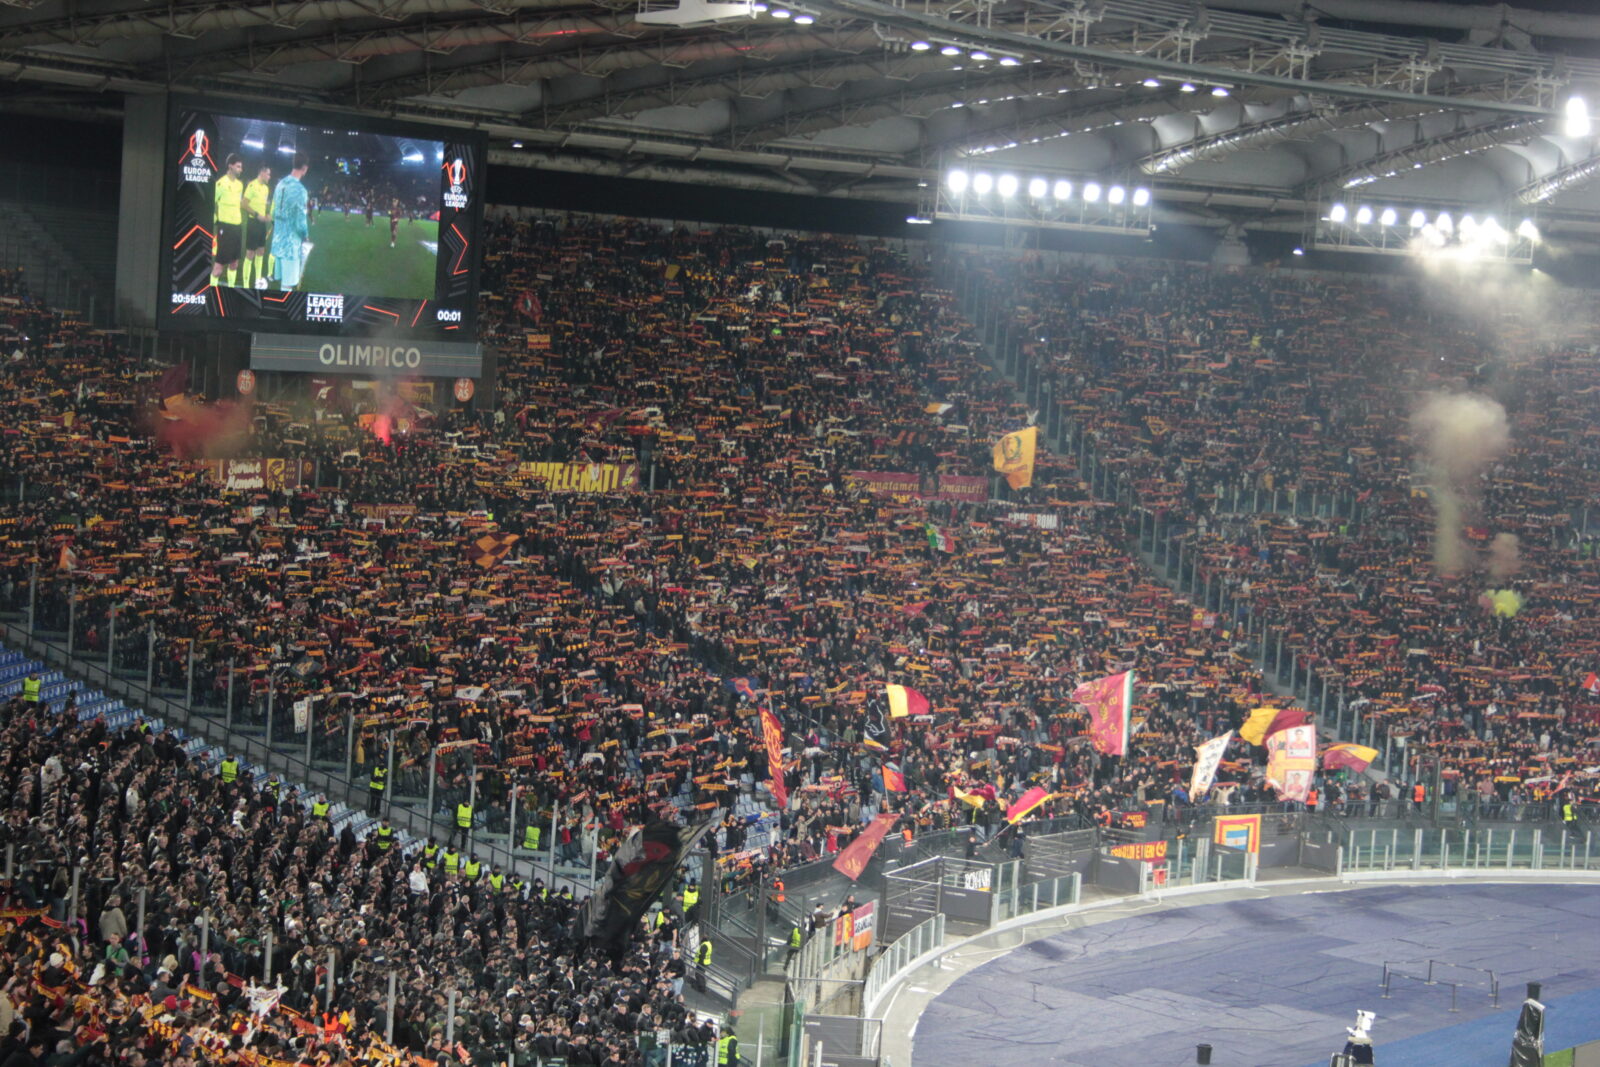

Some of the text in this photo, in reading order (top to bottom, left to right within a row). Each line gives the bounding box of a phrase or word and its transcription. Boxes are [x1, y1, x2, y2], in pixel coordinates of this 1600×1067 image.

[183, 166, 211, 176] EUROPA
[185, 174, 209, 183] LEAGUE
[443, 193, 468, 202] EUROPA
[445, 200, 466, 208] LEAGUE
[172, 293, 206, 304] 20:59:13
[307, 296, 343, 308] LEAGUE
[306, 307, 343, 316] PHASE
[437, 309, 462, 322] 00:01
[319, 343, 421, 368] OLIMPICO
